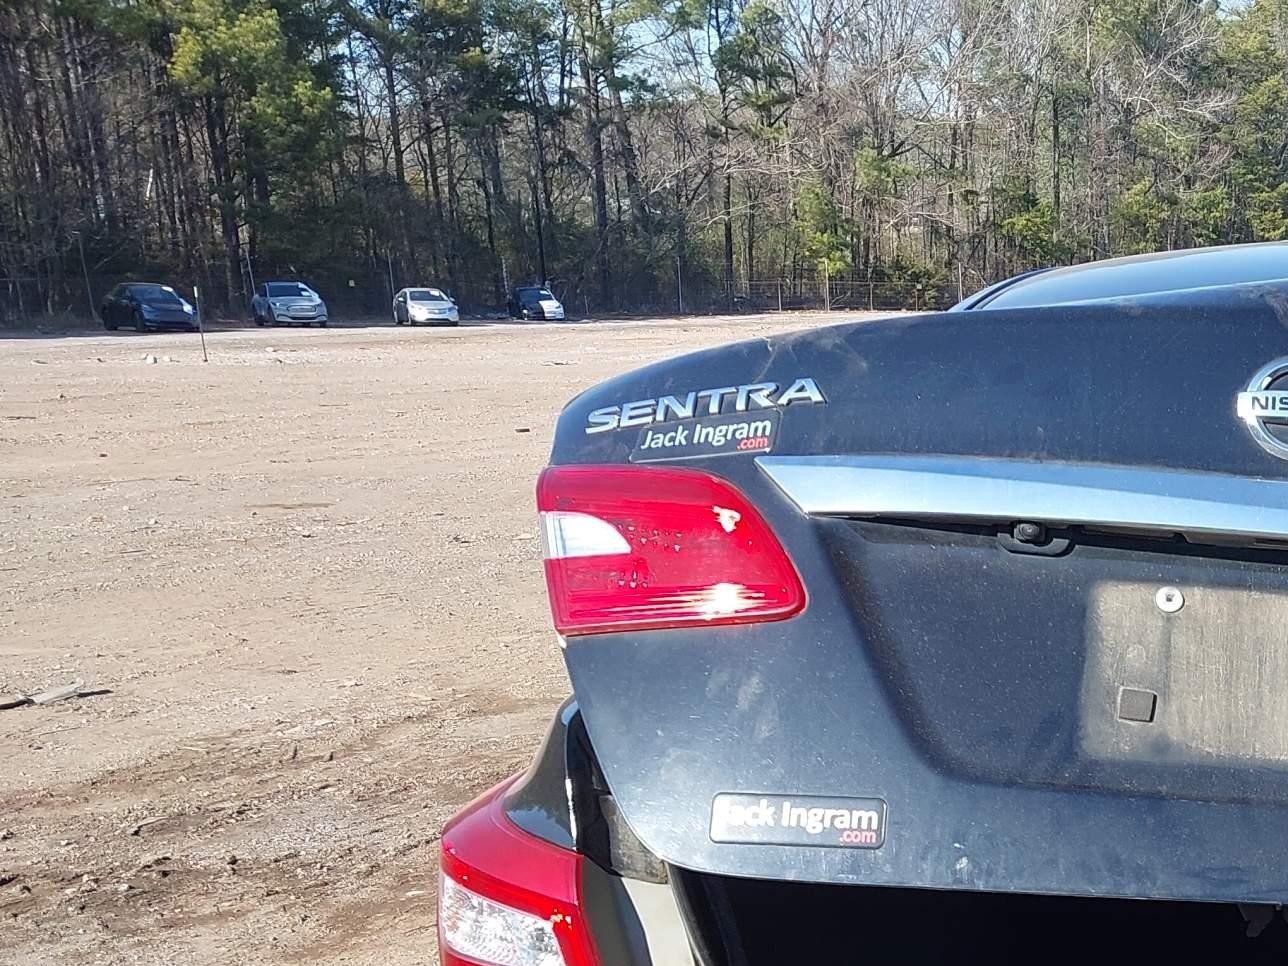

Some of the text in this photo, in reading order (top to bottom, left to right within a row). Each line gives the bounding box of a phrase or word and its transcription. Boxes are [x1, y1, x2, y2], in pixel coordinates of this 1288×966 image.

[585, 378, 828, 434] SENTRA
[640, 418, 772, 450] Jack Ingram
[736, 436, 768, 451] .com
[781, 801, 879, 834] Ingram
[840, 830, 877, 844] .com
